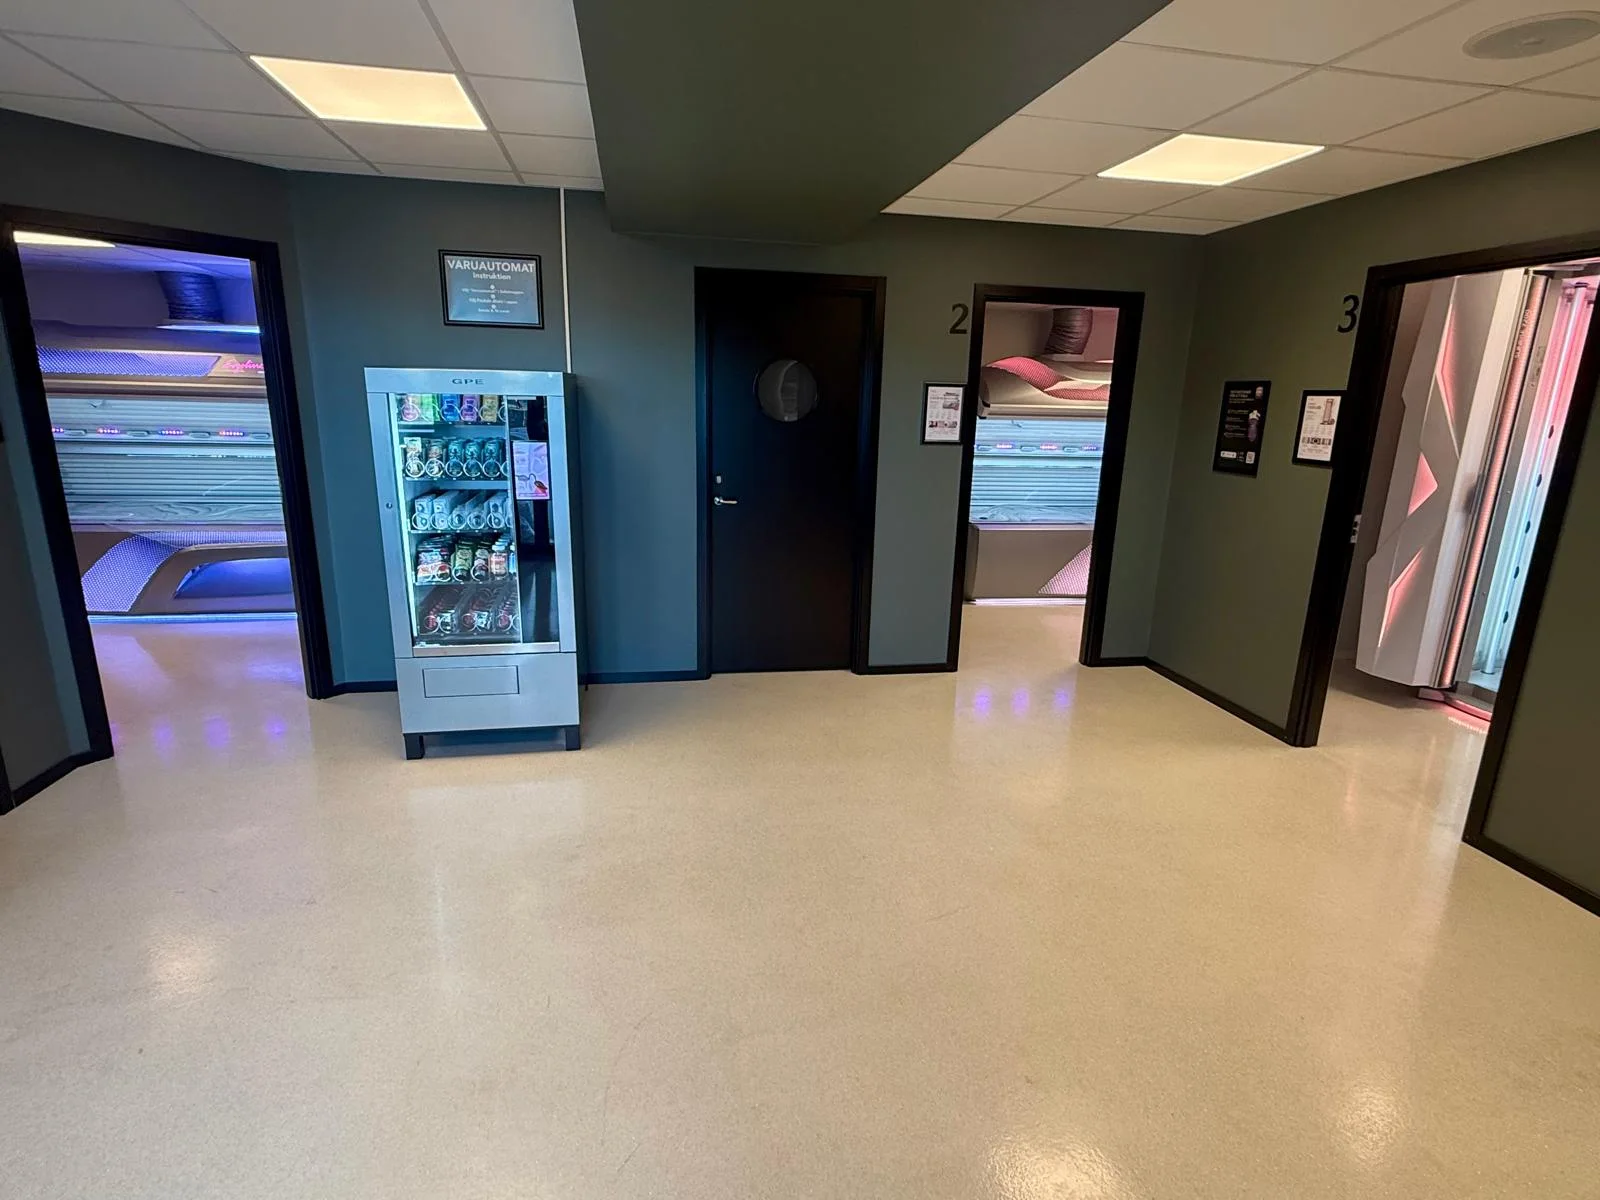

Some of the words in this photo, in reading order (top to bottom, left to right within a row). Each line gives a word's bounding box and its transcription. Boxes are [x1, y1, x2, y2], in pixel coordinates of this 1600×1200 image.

[447, 259, 535, 273] VARUAUTOMAT
[472, 272, 511, 280] Instruktion
[949, 303, 969, 335] 2
[1337, 294, 1360, 333] 3
[451, 378, 485, 386] GPE
